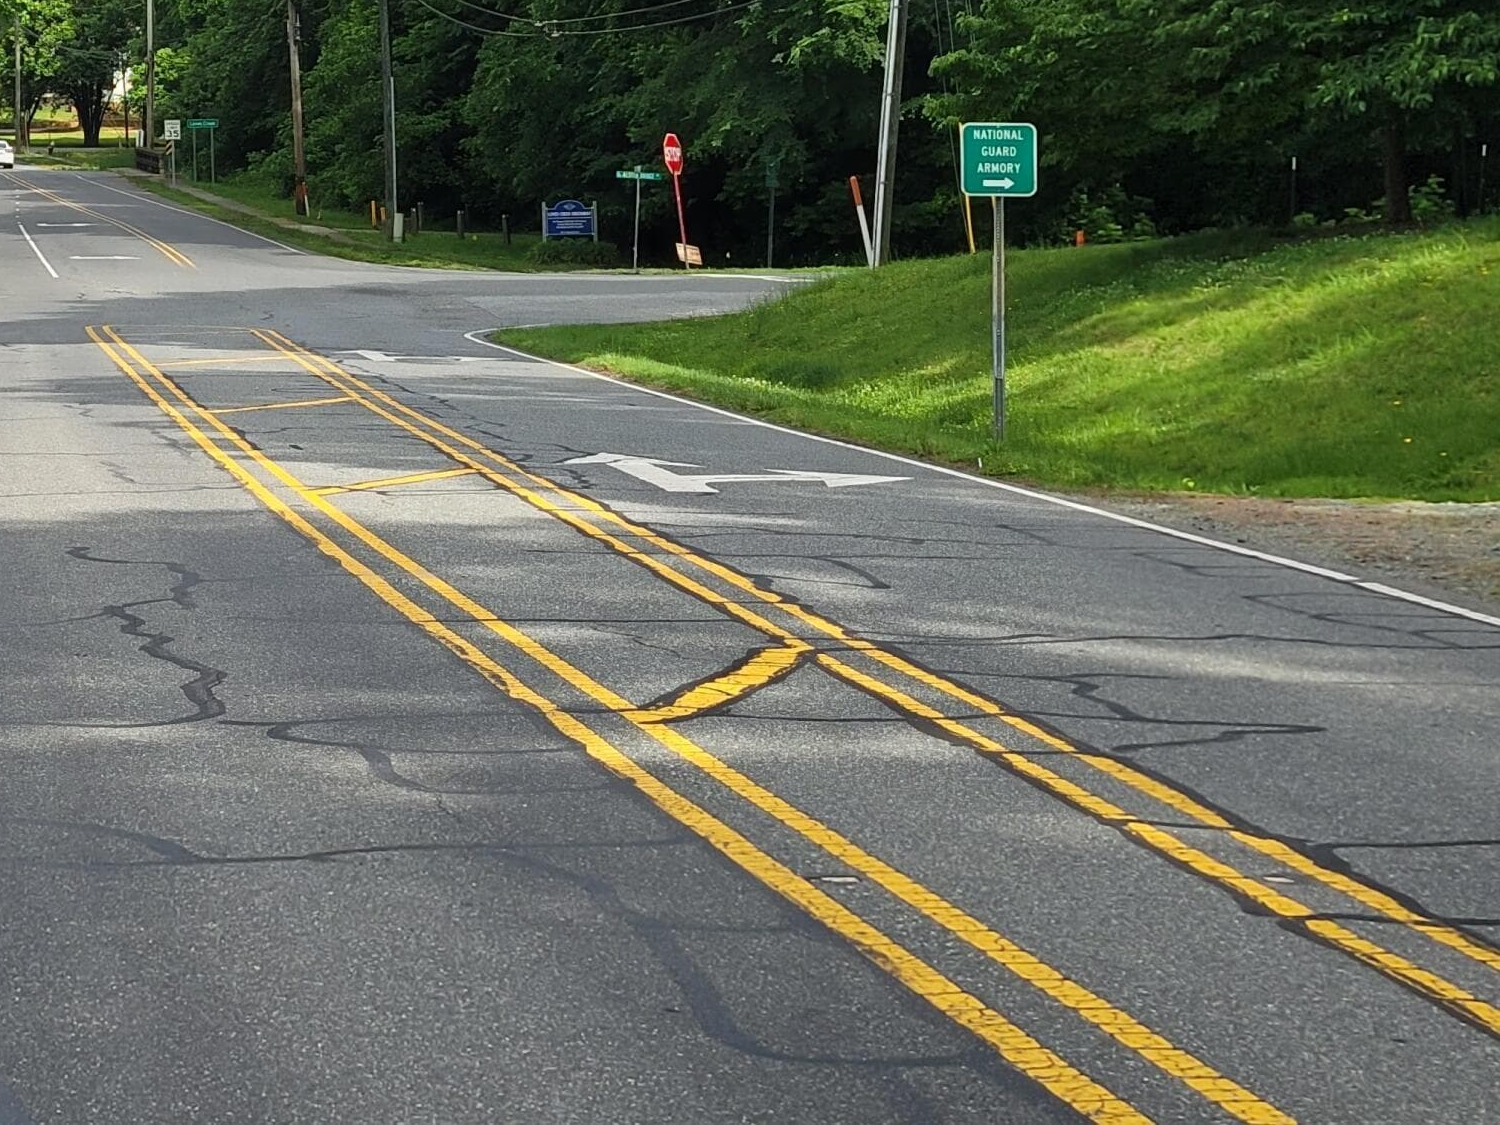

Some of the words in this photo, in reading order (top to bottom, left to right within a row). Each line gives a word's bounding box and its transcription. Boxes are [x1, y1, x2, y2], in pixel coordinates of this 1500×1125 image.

[166, 130, 179, 138] 35
[973, 129, 1024, 140] NATIONAL
[664, 147, 681, 162] STOP
[981, 146, 1017, 157] GUARD
[977, 162, 1021, 174] ARMORY
